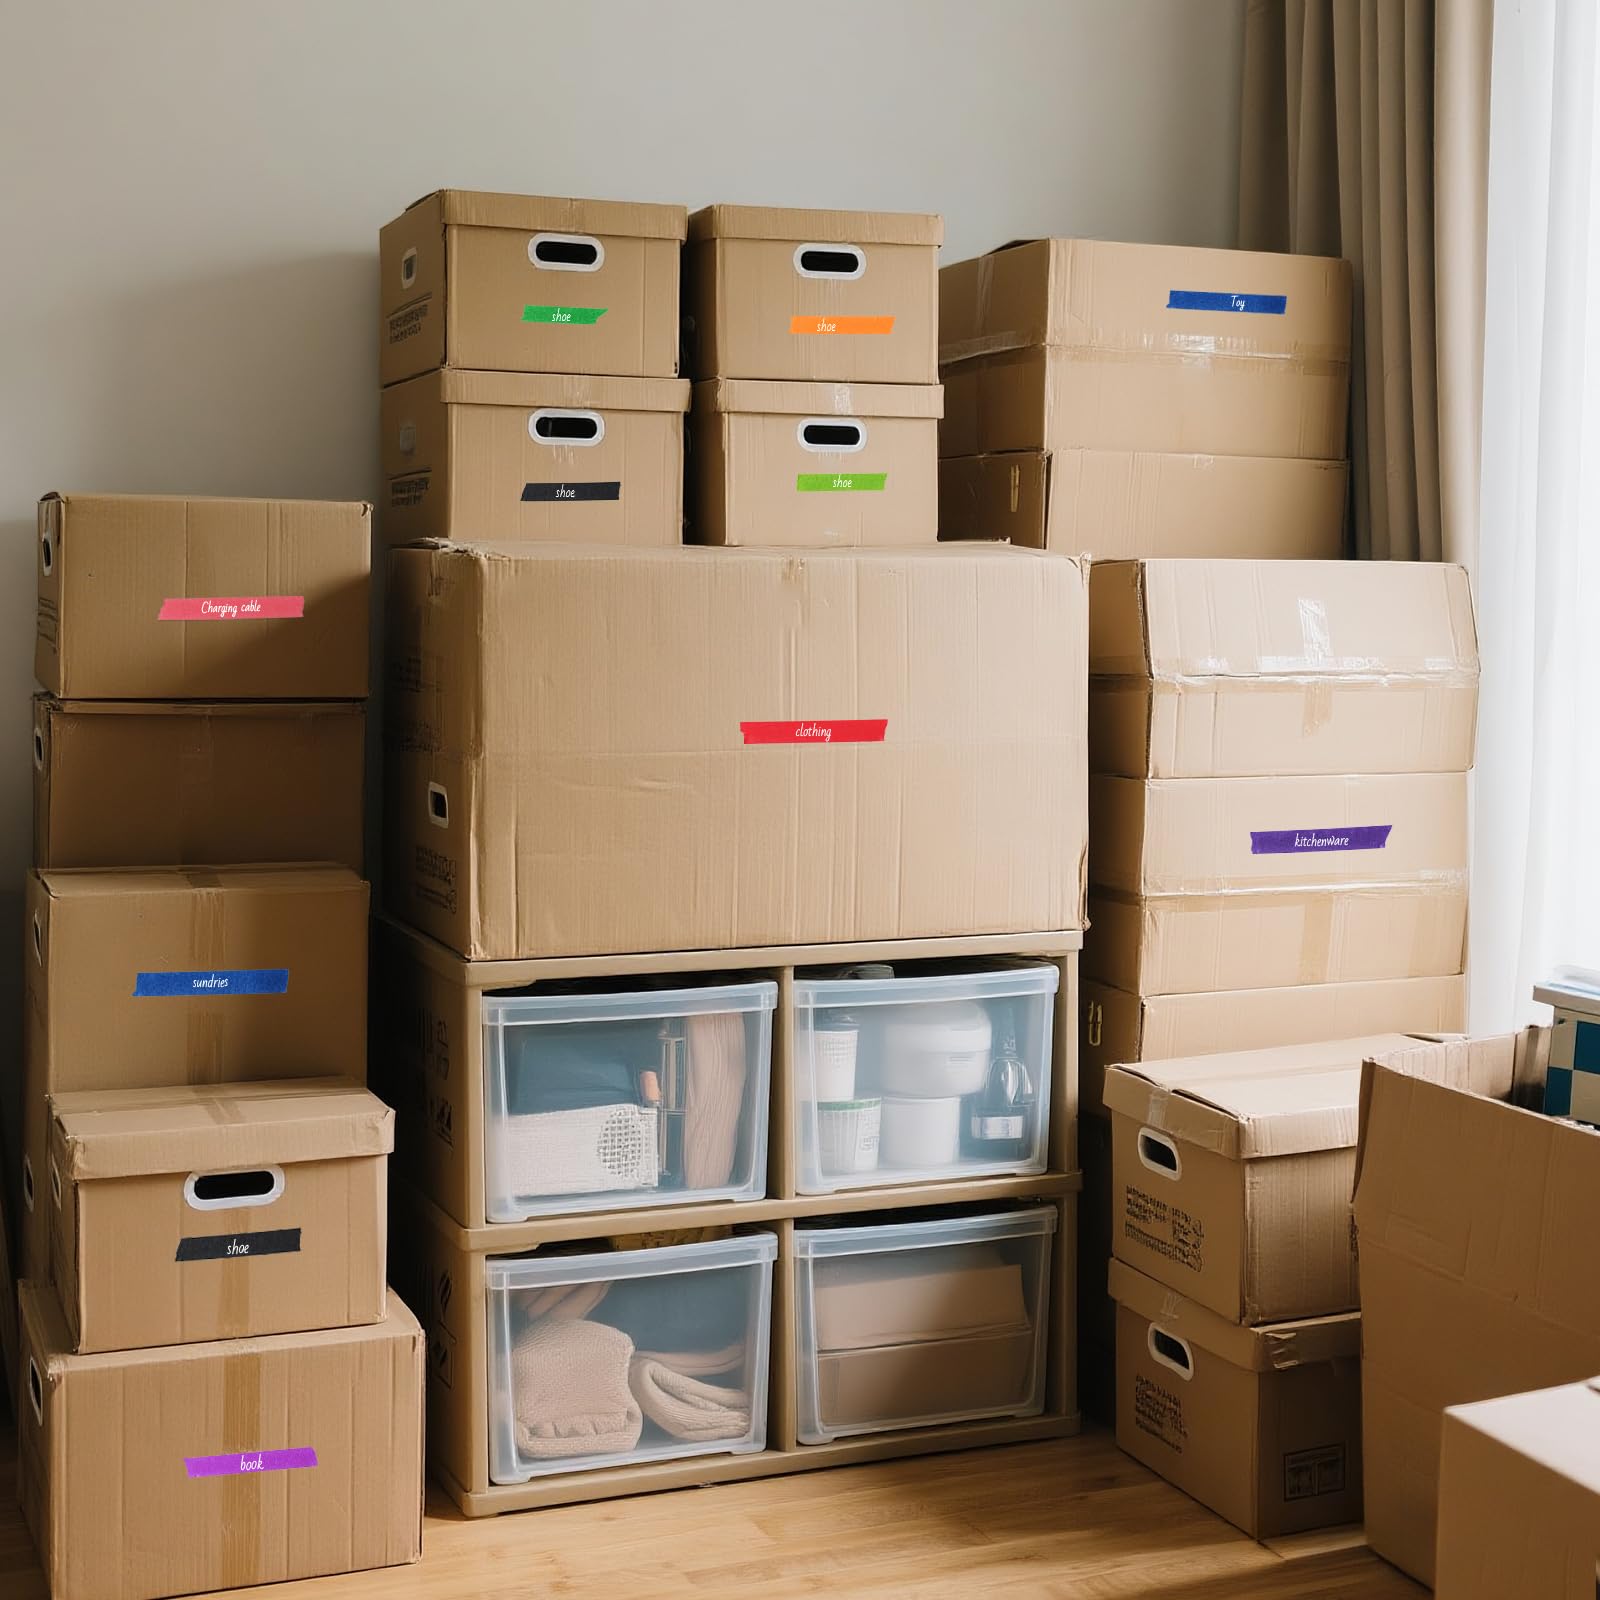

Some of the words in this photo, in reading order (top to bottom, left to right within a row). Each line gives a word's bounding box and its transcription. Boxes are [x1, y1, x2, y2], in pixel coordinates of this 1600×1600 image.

[1231, 295, 1246, 311] Toy
[551, 308, 571, 322] shoe
[816, 318, 837, 333] shoe
[832, 475, 852, 488] shoe
[555, 484, 576, 498] shoe
[201, 600, 238, 617] Charging
[241, 599, 261, 612] cable
[795, 722, 832, 741] clothing
[1294, 832, 1350, 847] kitchenware
[192, 973, 229, 988] sundries
[227, 1238, 250, 1254] shoe
[240, 1453, 265, 1471] book
